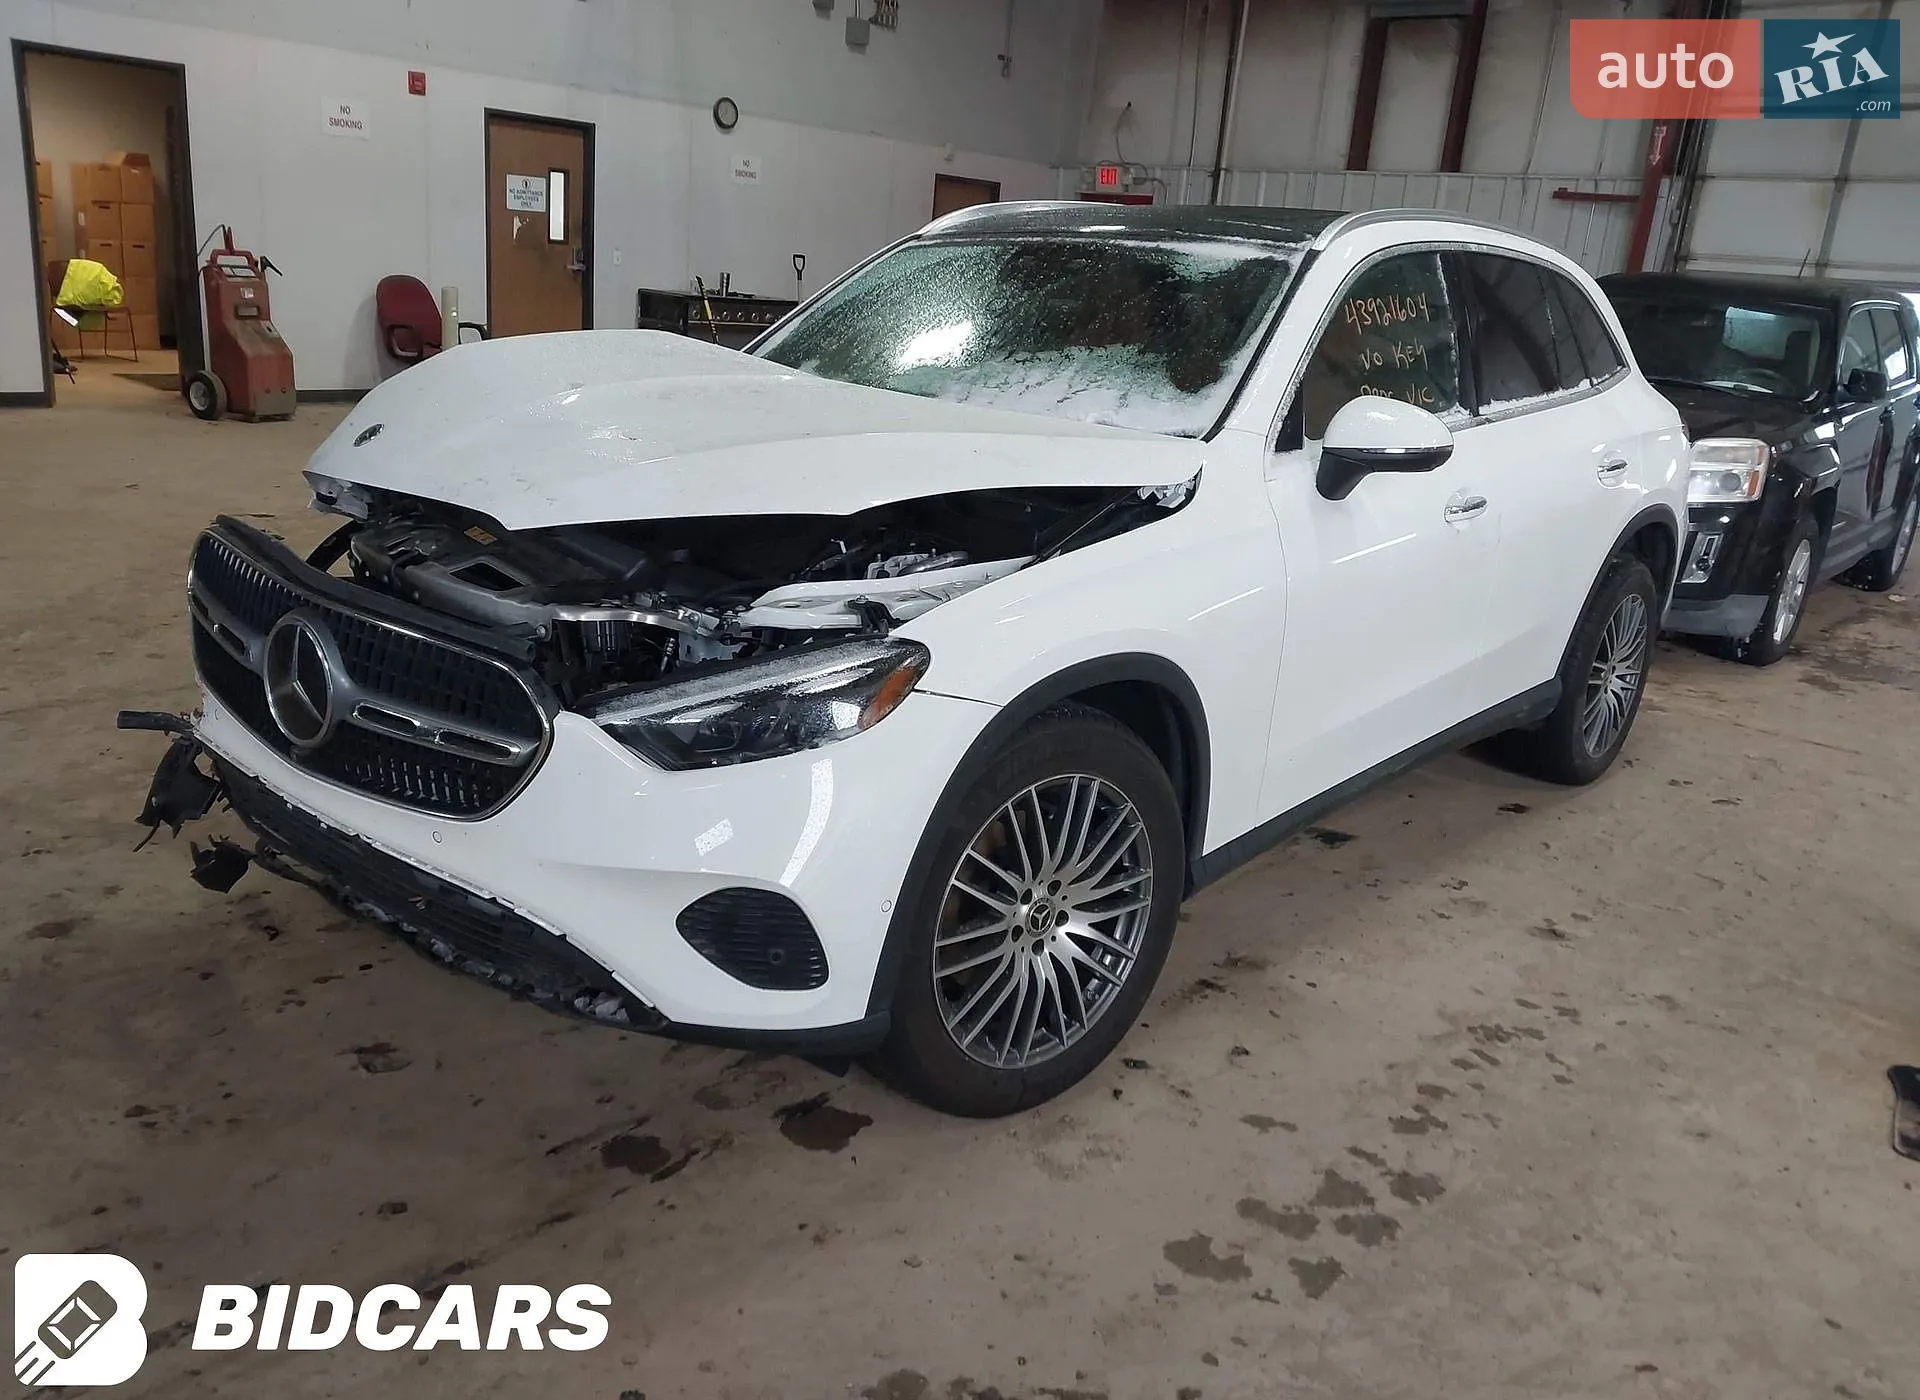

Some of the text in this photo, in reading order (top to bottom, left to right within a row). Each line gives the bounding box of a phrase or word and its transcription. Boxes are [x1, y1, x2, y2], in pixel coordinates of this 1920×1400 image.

[340, 104, 351, 115] NO
[328, 117, 363, 130] SMOKING
[1101, 168, 1117, 185] EXIT
[1345, 292, 1430, 335] 43921604
[1392, 337, 1428, 371] KEY
